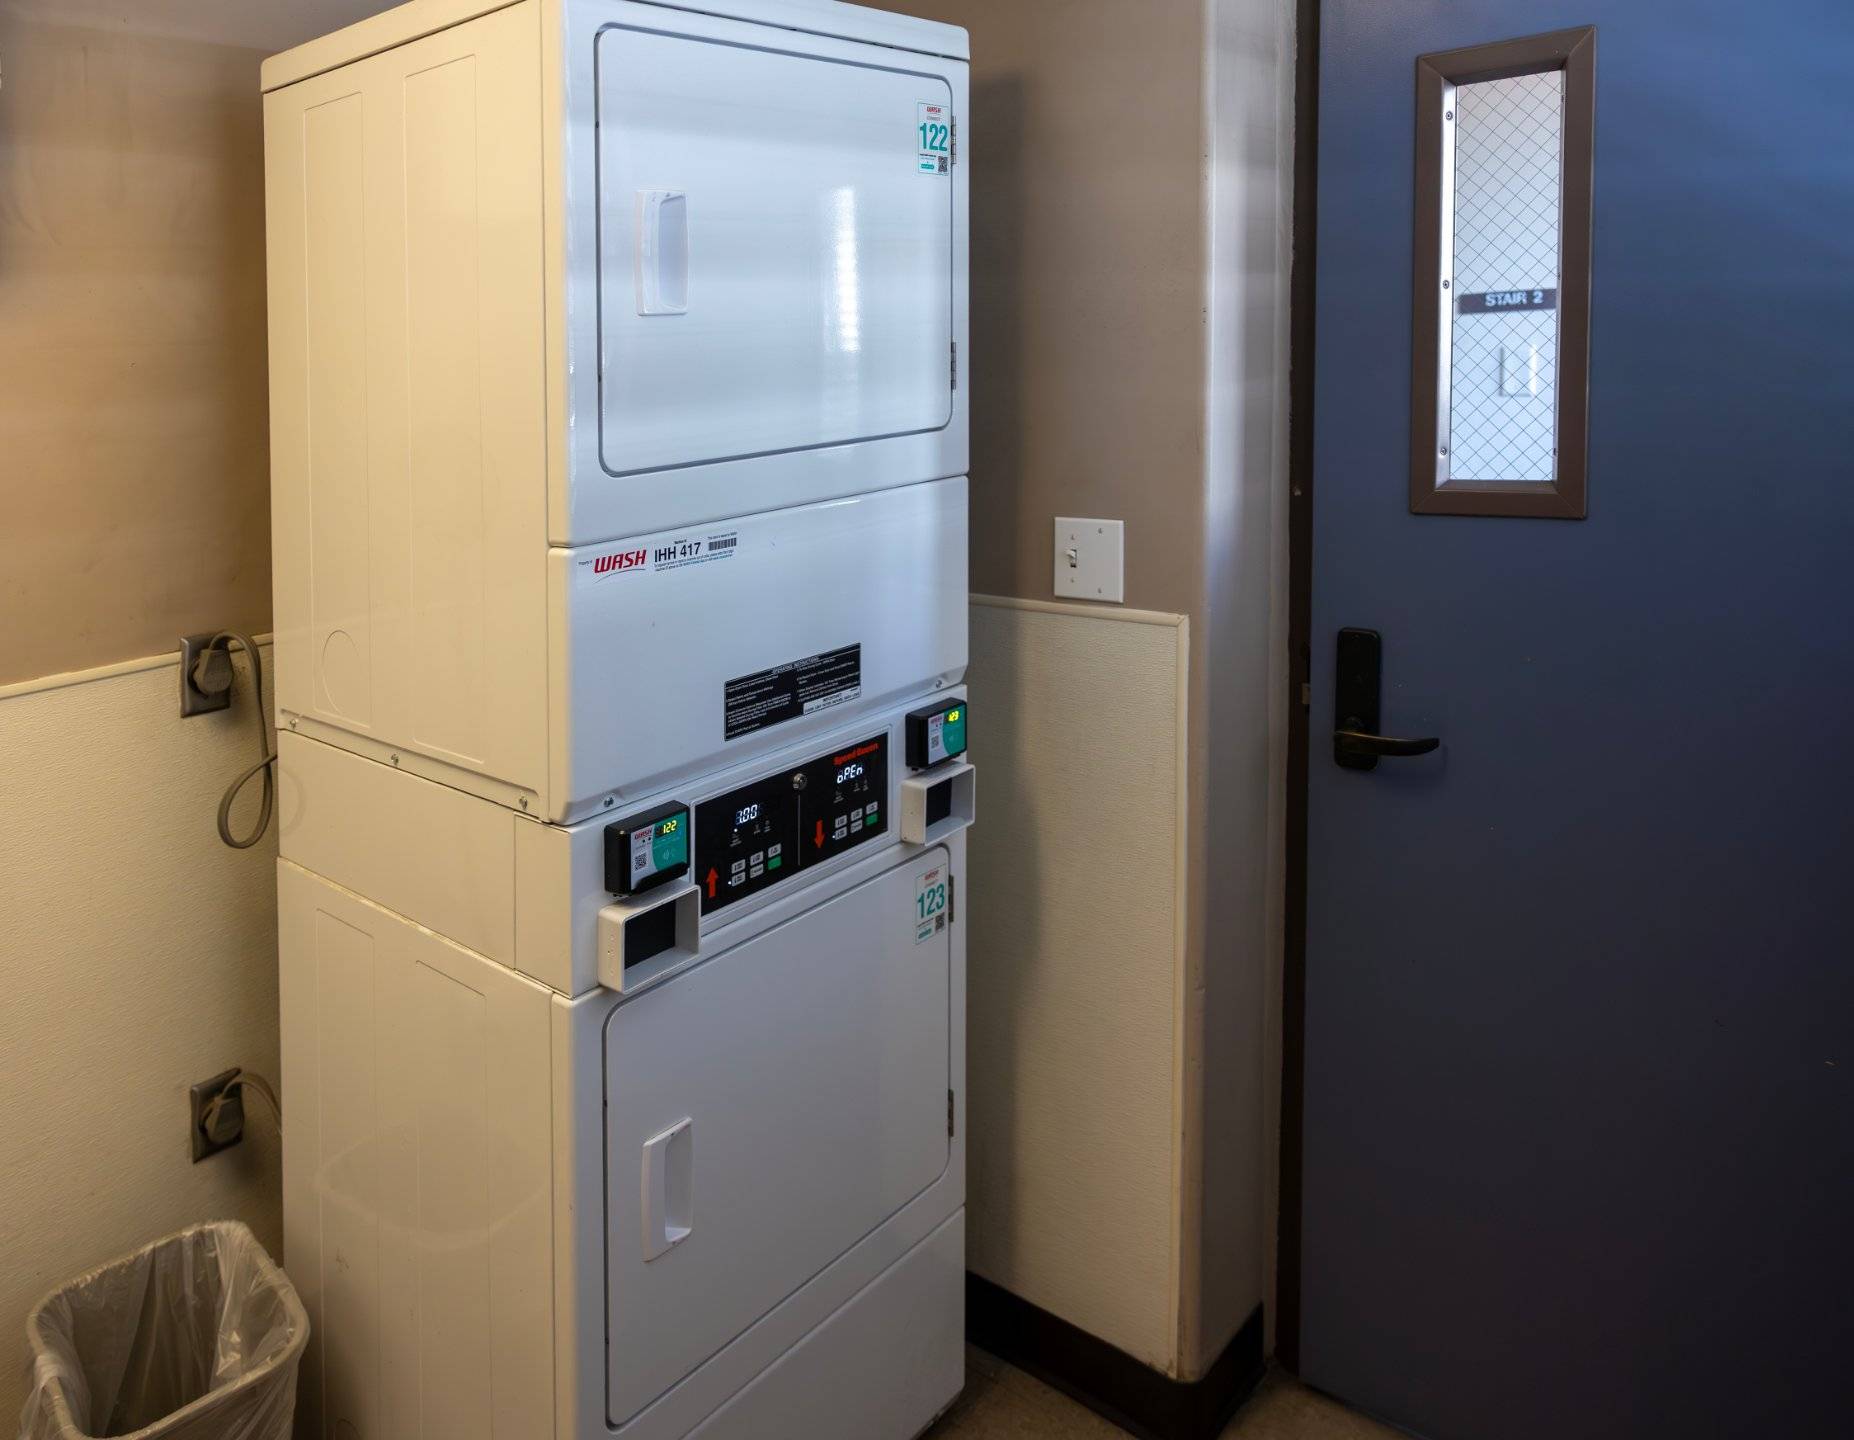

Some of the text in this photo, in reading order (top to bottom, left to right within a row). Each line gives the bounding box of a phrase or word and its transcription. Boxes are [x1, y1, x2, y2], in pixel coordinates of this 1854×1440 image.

[920, 123, 948, 151] 122
[1485, 290, 1544, 307] STAIR 2
[594, 549, 647, 574] WASH
[655, 546, 676, 563] IHH
[680, 542, 701, 557] 417
[663, 819, 677, 834] 122
[917, 883, 945, 919] 123
